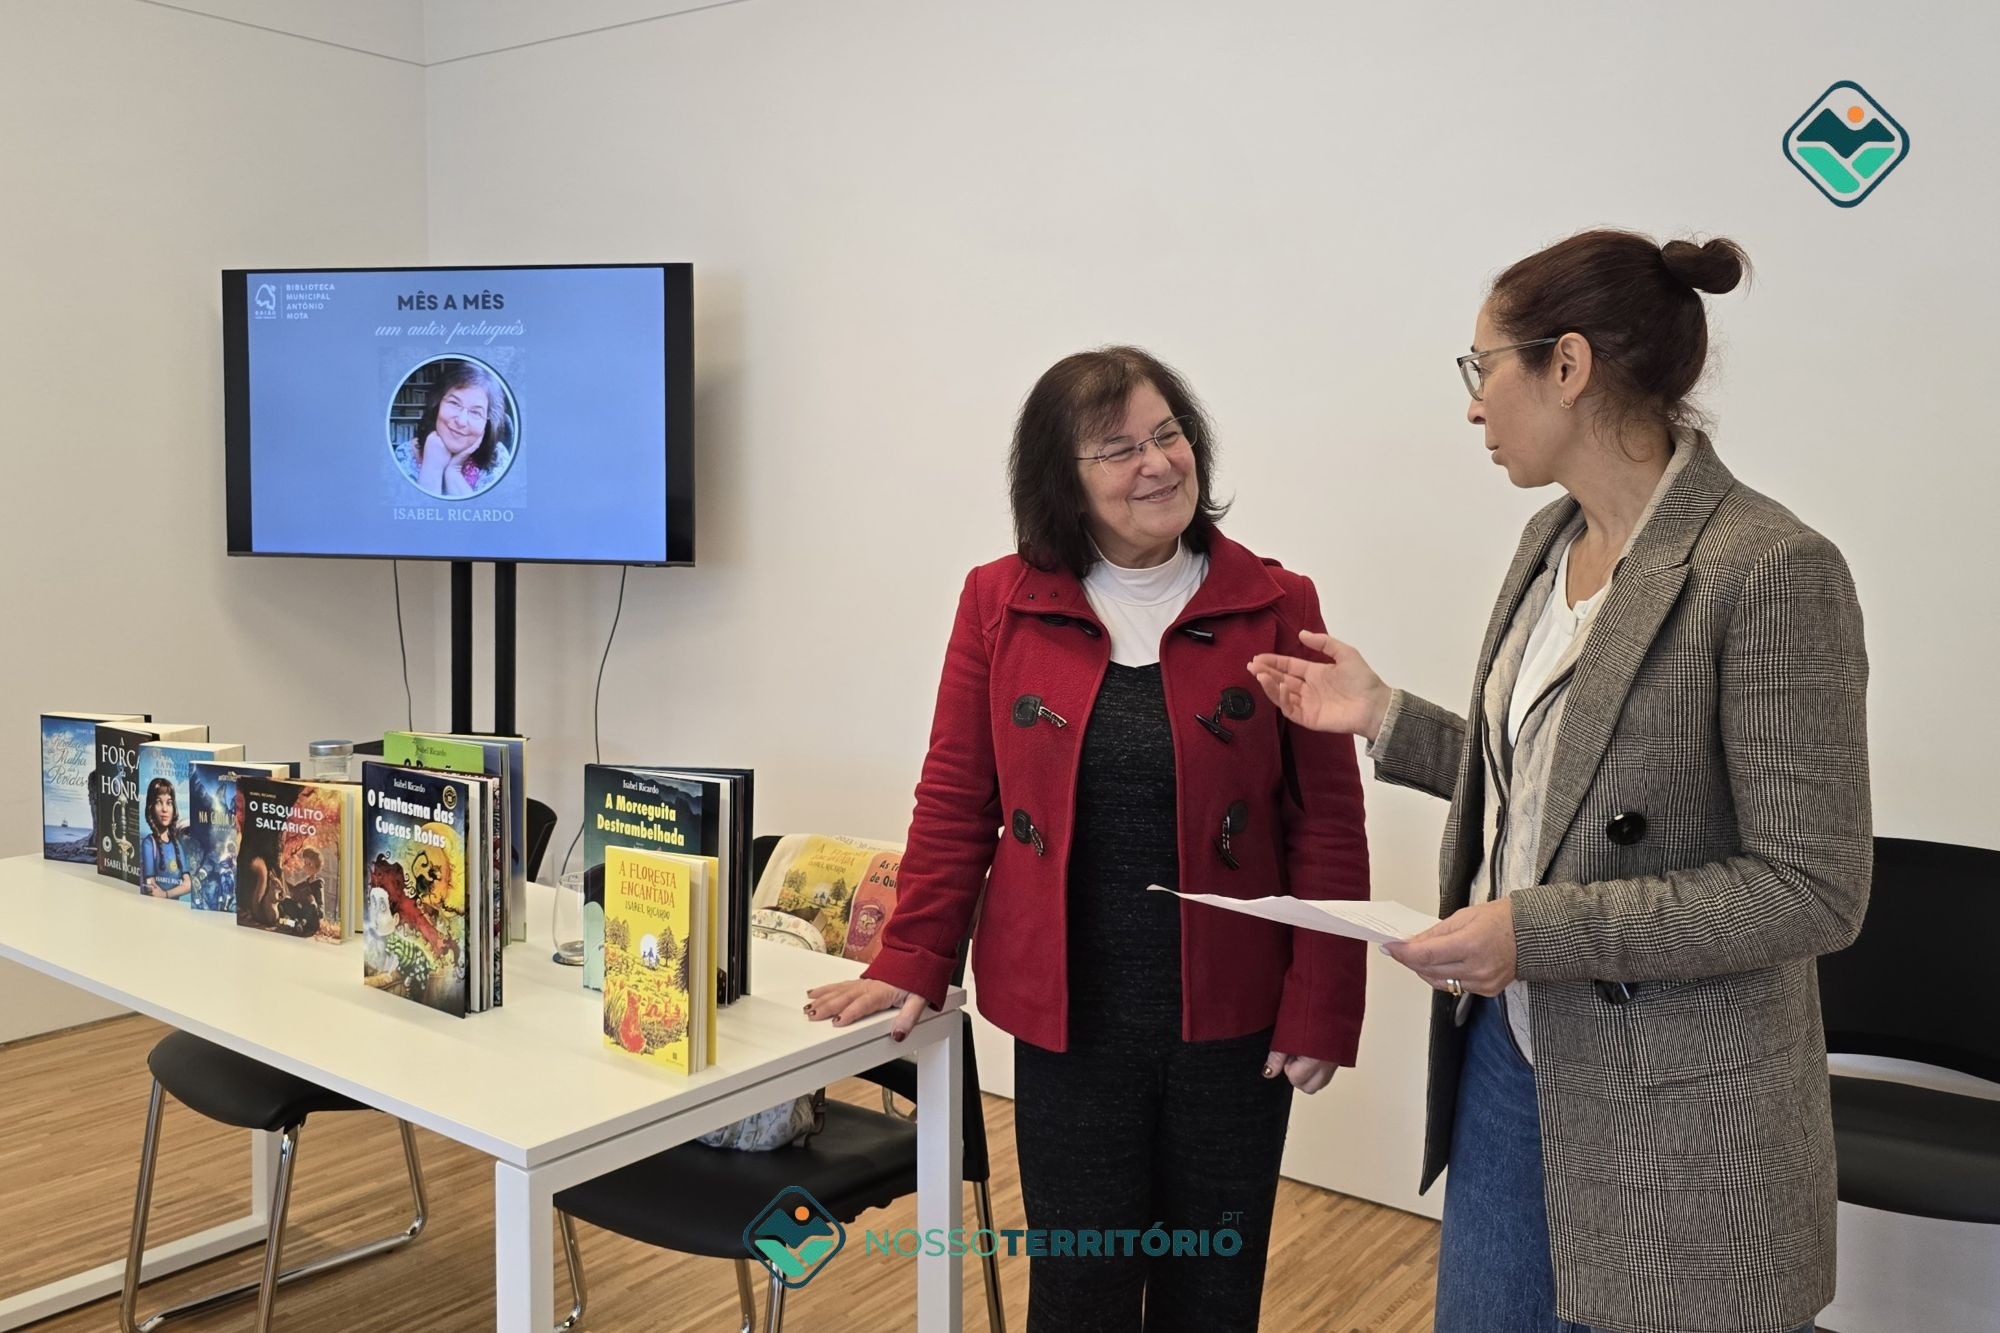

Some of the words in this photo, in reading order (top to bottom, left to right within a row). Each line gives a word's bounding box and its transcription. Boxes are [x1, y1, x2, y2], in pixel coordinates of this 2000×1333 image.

[286, 283, 335, 291] BIBLIOTECA
[286, 293, 331, 301] MUNICIPAL
[286, 302, 324, 310] ANTÓNIO
[397, 290, 438, 311] MÊS
[443, 294, 457, 310] A
[463, 289, 504, 310] MÊS
[286, 312, 309, 320] MOTA
[375, 326, 402, 336] um
[407, 320, 448, 336] autor
[445, 319, 526, 345] português
[393, 507, 443, 521] ISABEL
[447, 509, 514, 523] RICARDO
[119, 737, 125, 746] A
[101, 775, 140, 803] HONR
[393, 778, 407, 789] Isabel
[408, 781, 426, 793] Ricardo
[623, 779, 638, 791] Isabel
[638, 782, 660, 794] Ricardo
[249, 801, 258, 812] O
[262, 802, 325, 821] ESQUILITO
[367, 789, 376, 807] O
[378, 791, 430, 820] Fantasma
[433, 803, 455, 825] das
[604, 793, 613, 810] A
[616, 795, 676, 822] Morceguita
[255, 817, 317, 836] SALTARICO
[375, 815, 411, 840] Cuecas
[414, 825, 446, 848] Rotas
[597, 813, 685, 847] Destrambelhada
[104, 857, 121, 870] ISABEL
[122, 860, 140, 877] RICARD
[618, 860, 626, 877] A
[629, 862, 677, 889] FLORESTA
[879, 859, 890, 870] As
[891, 863, 900, 872] Tr
[869, 872, 880, 884] de
[621, 880, 675, 909] ENCANTADA
[625, 900, 645, 914] ISABEL
[646, 905, 670, 921] RICARDO
